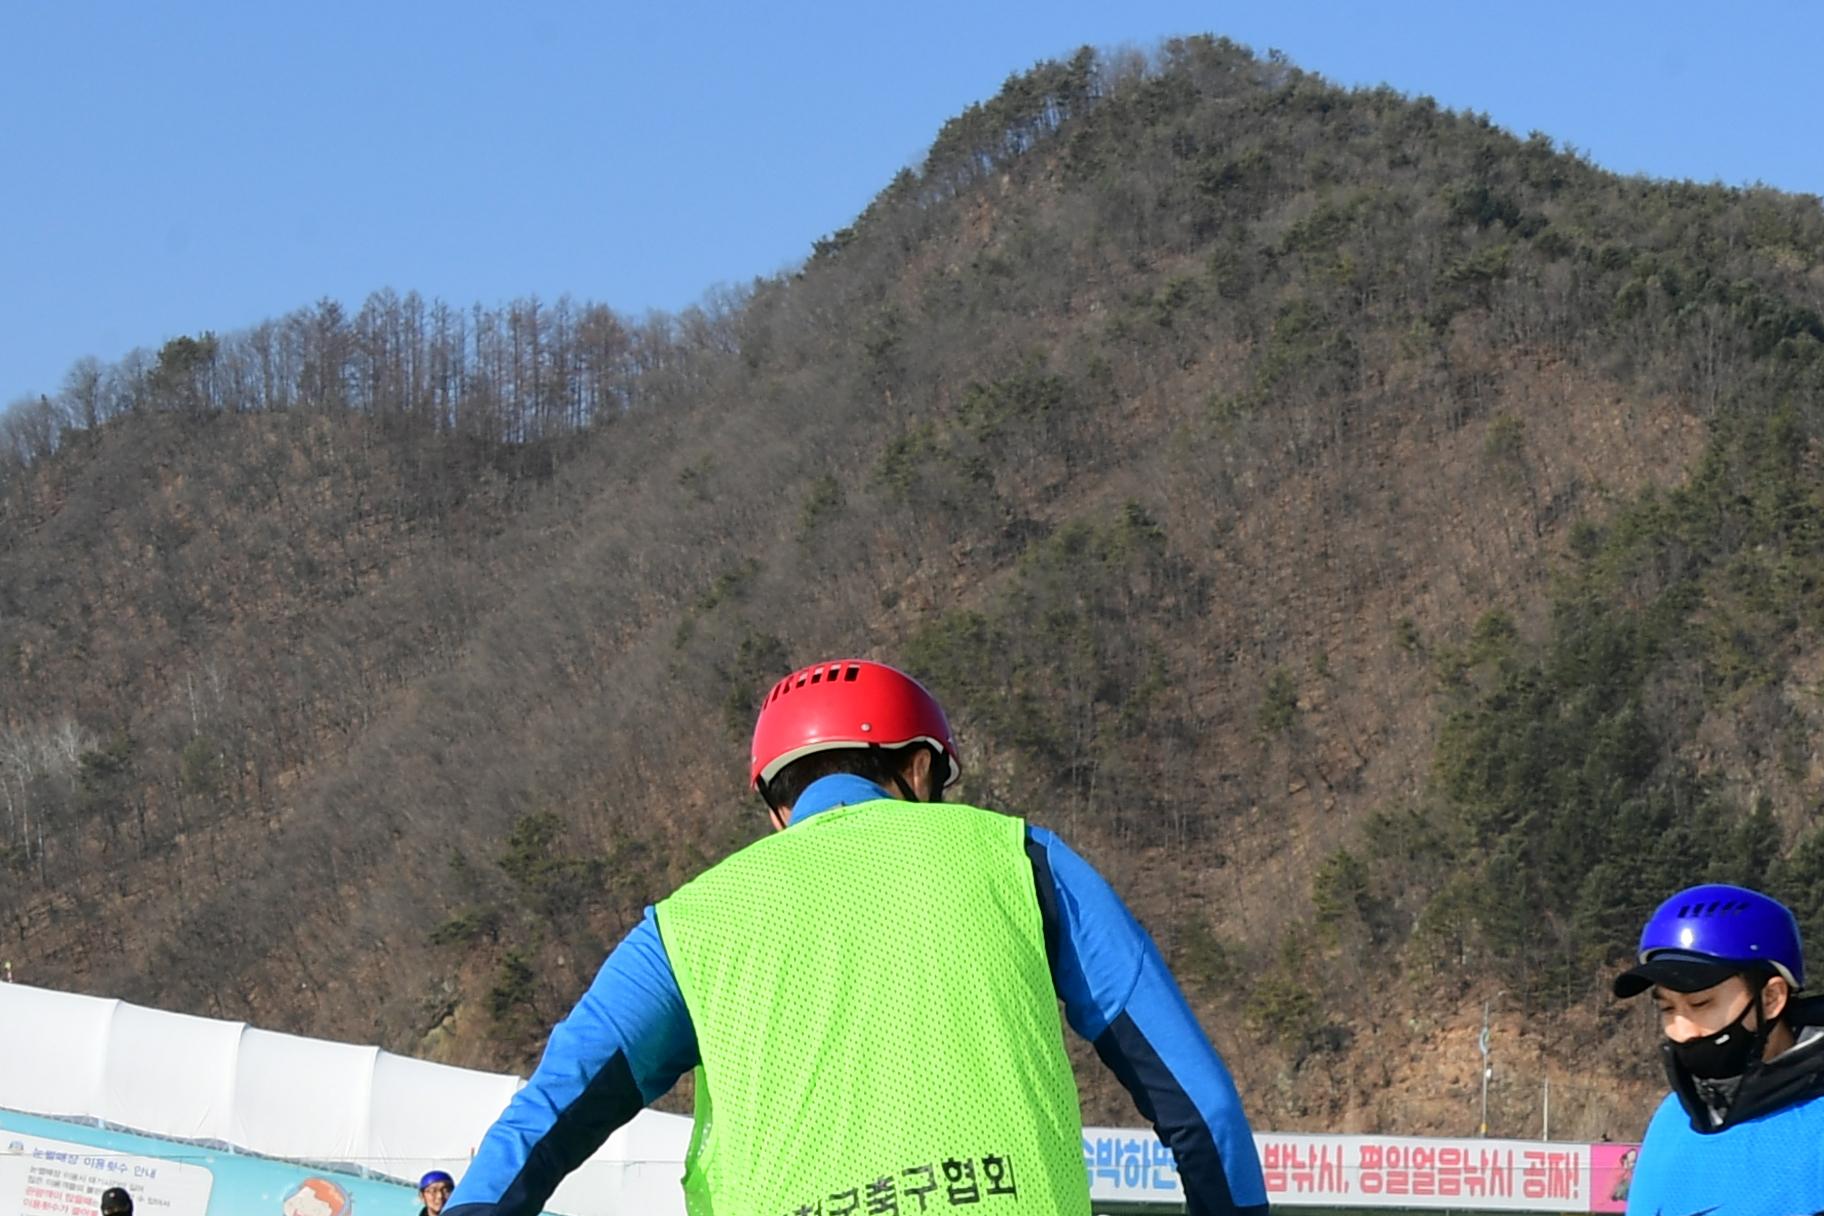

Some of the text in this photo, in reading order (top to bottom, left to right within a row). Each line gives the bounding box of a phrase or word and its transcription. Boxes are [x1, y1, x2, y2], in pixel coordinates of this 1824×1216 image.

[32, 1147, 79, 1166] 눈썰매장
[134, 1164, 157, 1180] 안내
[1264, 1143, 1350, 1194] 밤낚시,
[1359, 1145, 1513, 1198] 평일얼음낚시
[1523, 1151, 1580, 1200] 공짜!
